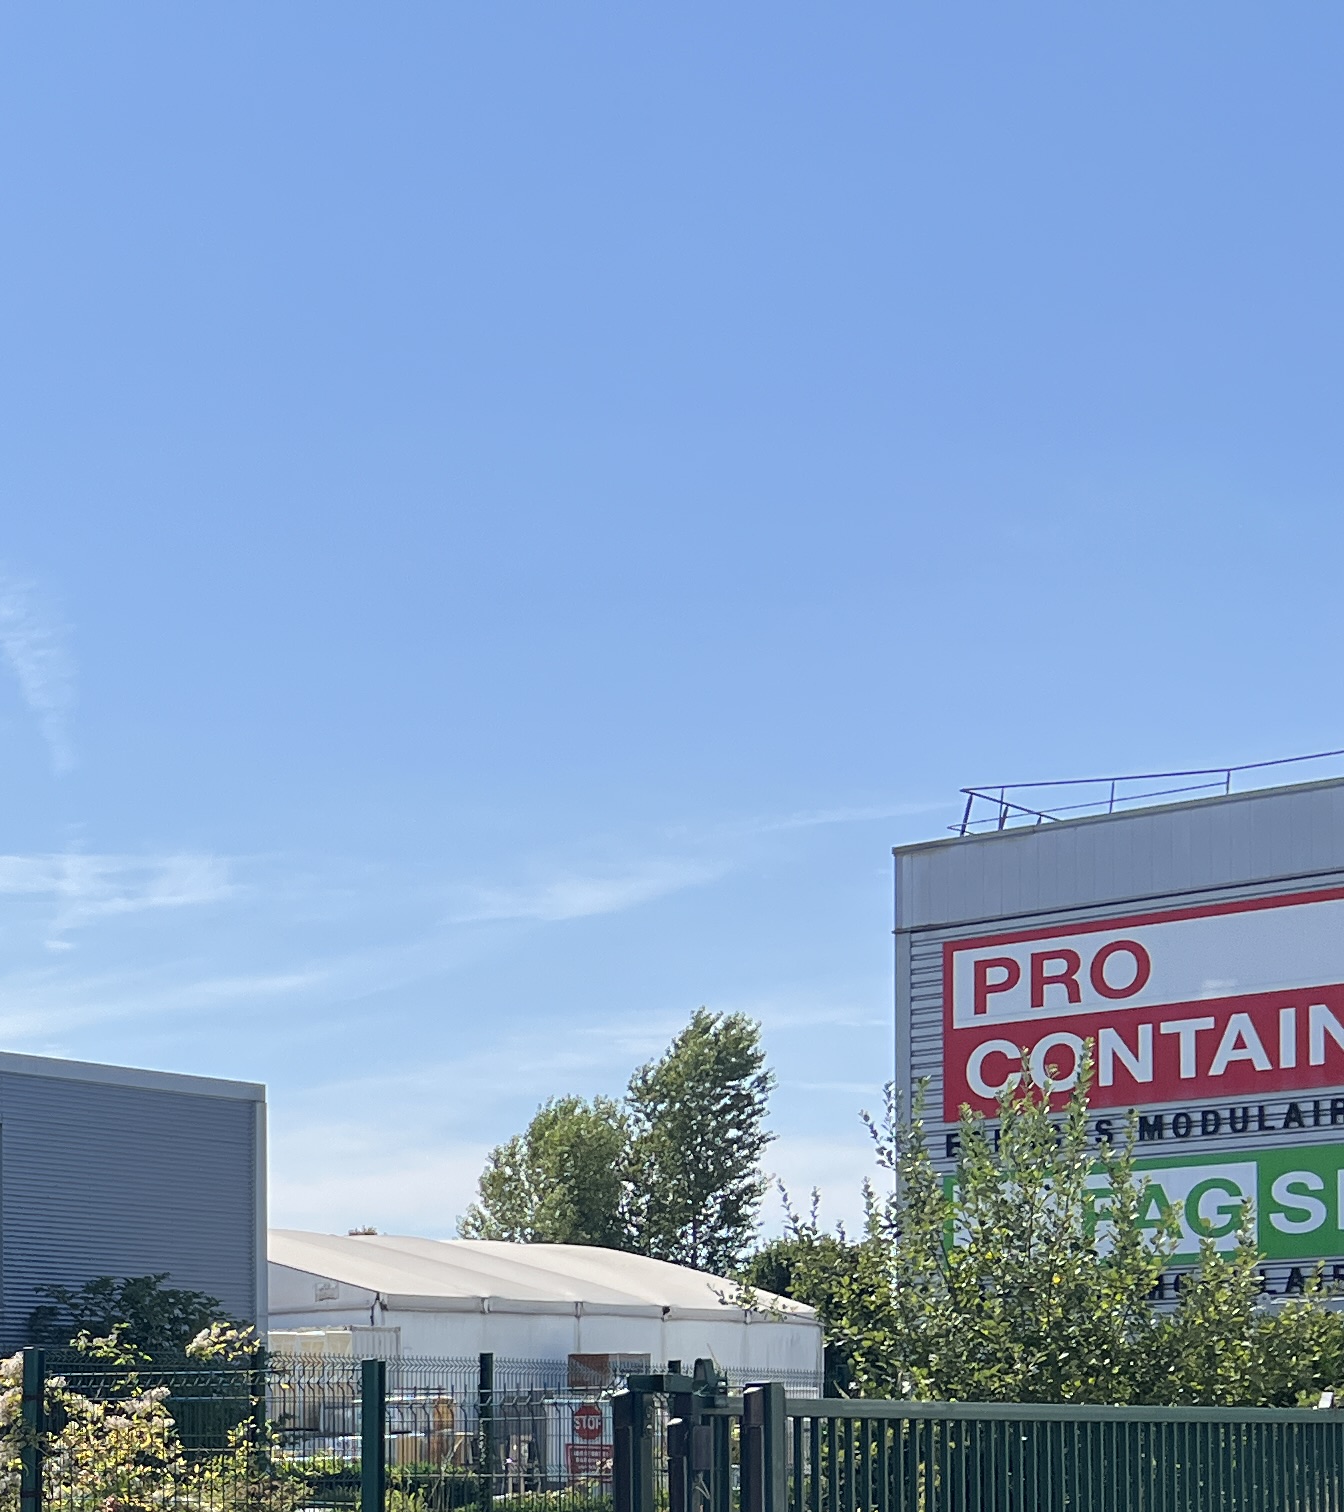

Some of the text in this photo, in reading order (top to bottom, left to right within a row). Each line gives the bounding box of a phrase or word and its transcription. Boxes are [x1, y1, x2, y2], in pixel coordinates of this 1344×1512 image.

[973, 939, 1151, 1016] PRO
[965, 1003, 1344, 1100] CONTAIN
[574, 1416, 601, 1430] STOP
